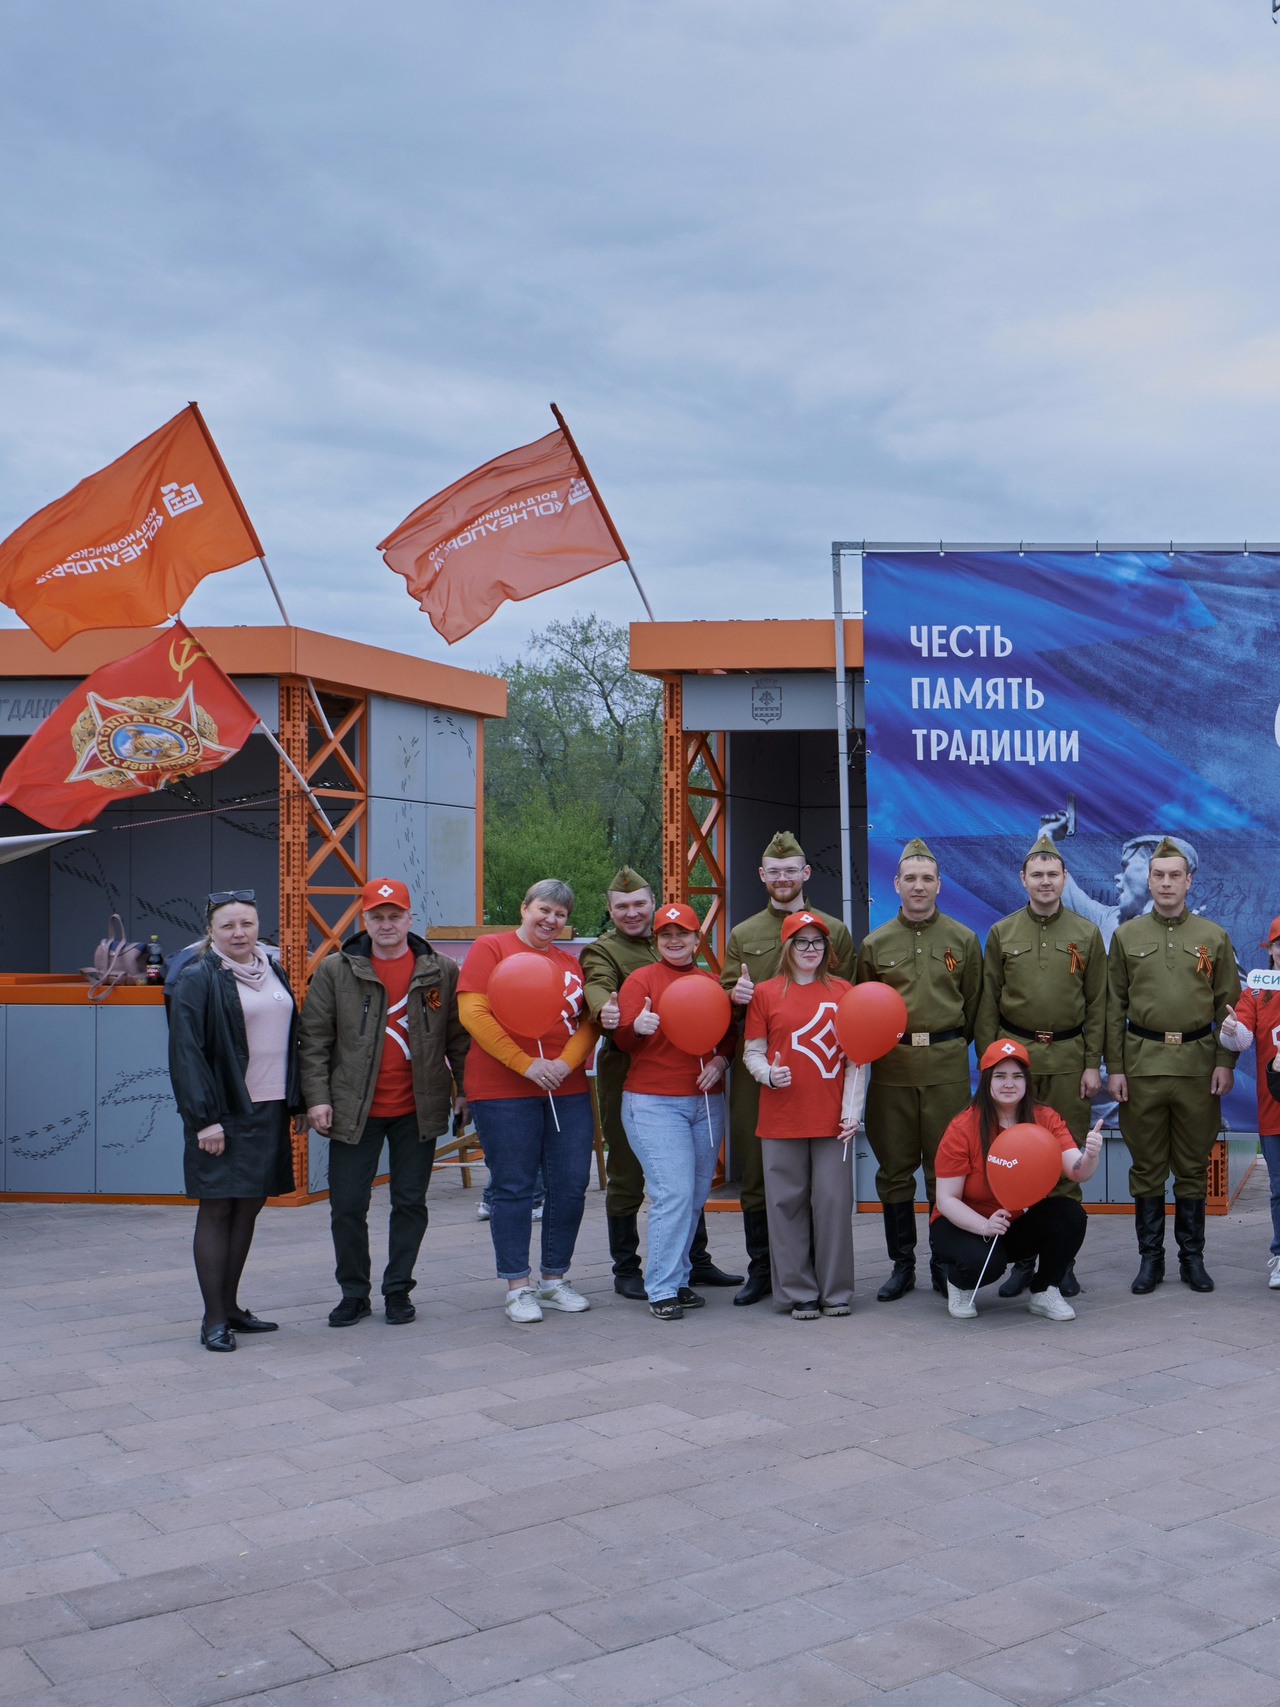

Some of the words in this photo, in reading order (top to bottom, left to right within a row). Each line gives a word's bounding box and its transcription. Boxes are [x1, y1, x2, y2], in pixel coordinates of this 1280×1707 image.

[910, 625, 1014, 659] ЧЕСТЬ
[911, 677, 1045, 710] ПАМЯТЬ
[911, 729, 1080, 765] ТРАДИЦИИ
[987, 1154, 1014, 1169] СИБАГРО
